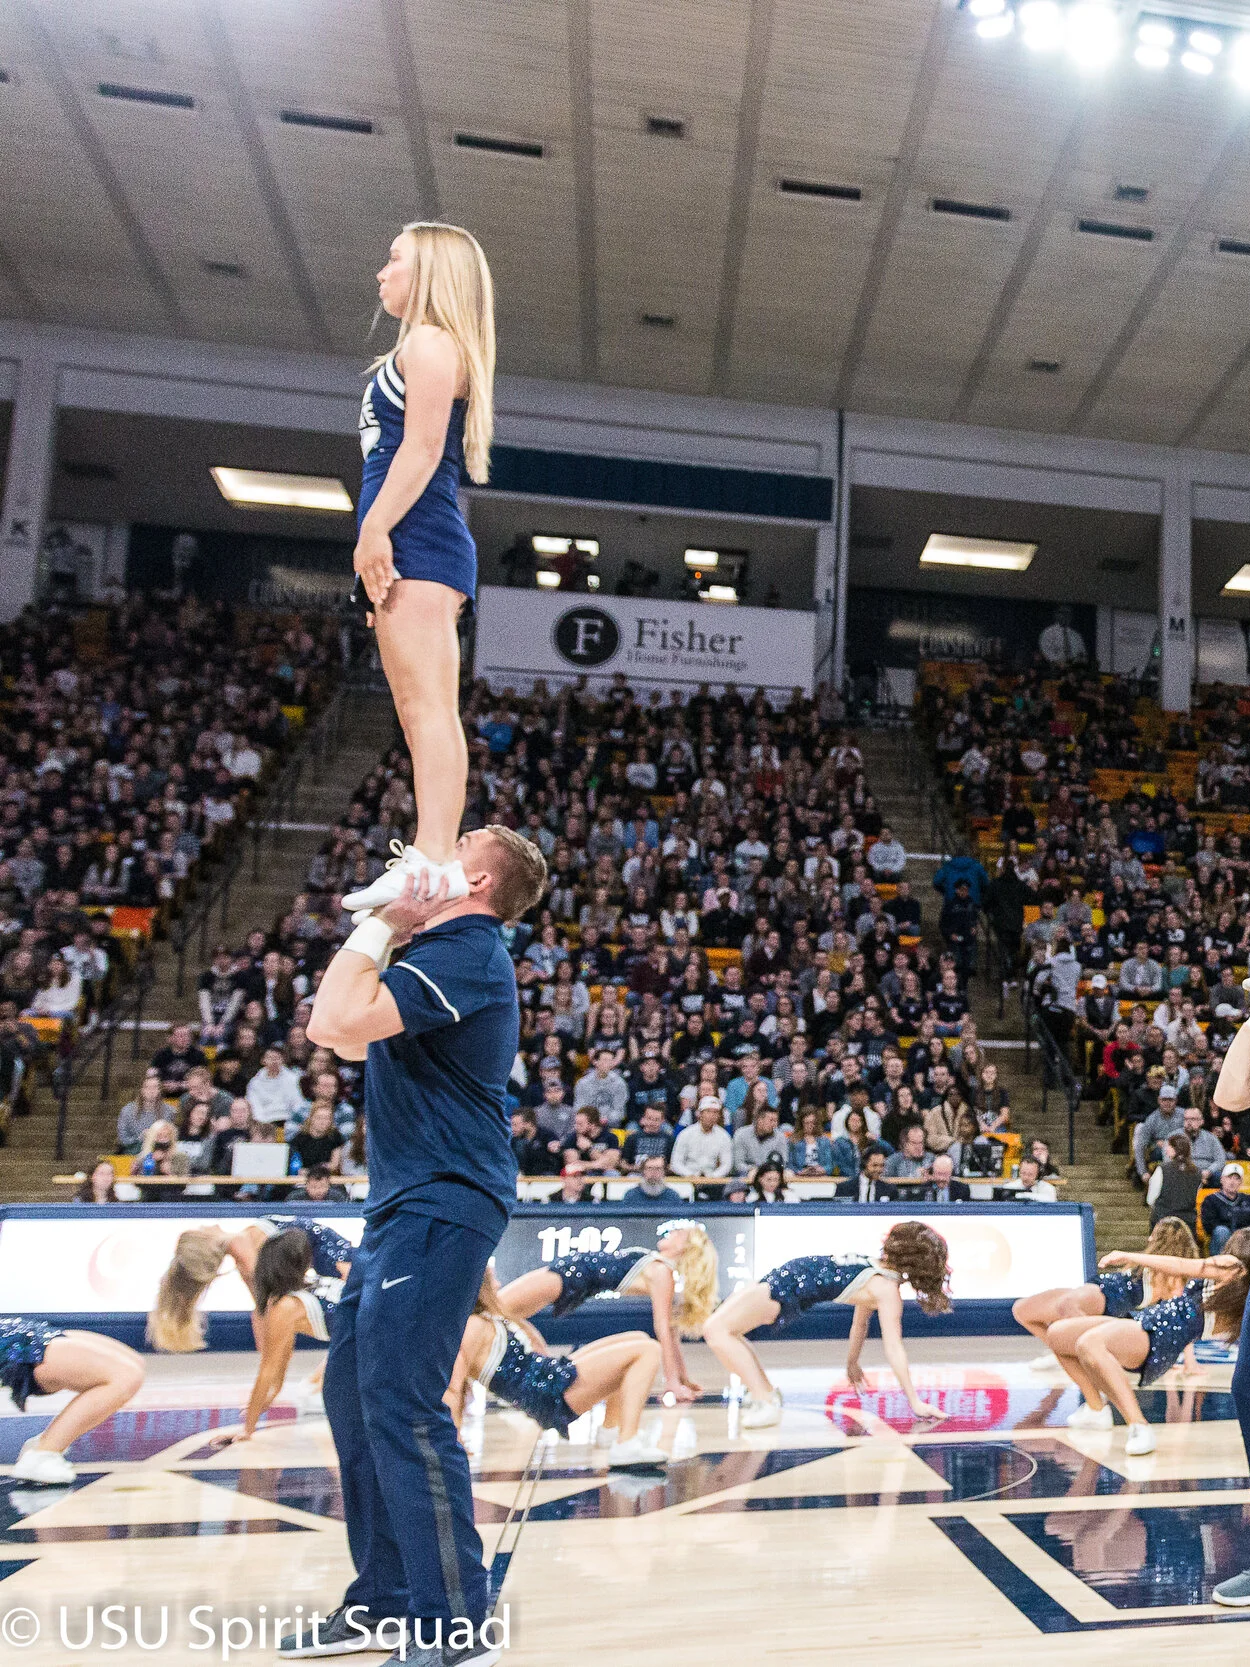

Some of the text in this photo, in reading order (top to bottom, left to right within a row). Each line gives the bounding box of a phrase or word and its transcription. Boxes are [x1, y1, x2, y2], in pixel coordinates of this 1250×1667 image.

[571, 617, 604, 656] F
[634, 617, 743, 655] Fisher
[627, 651, 749, 672] Home Furnishings
